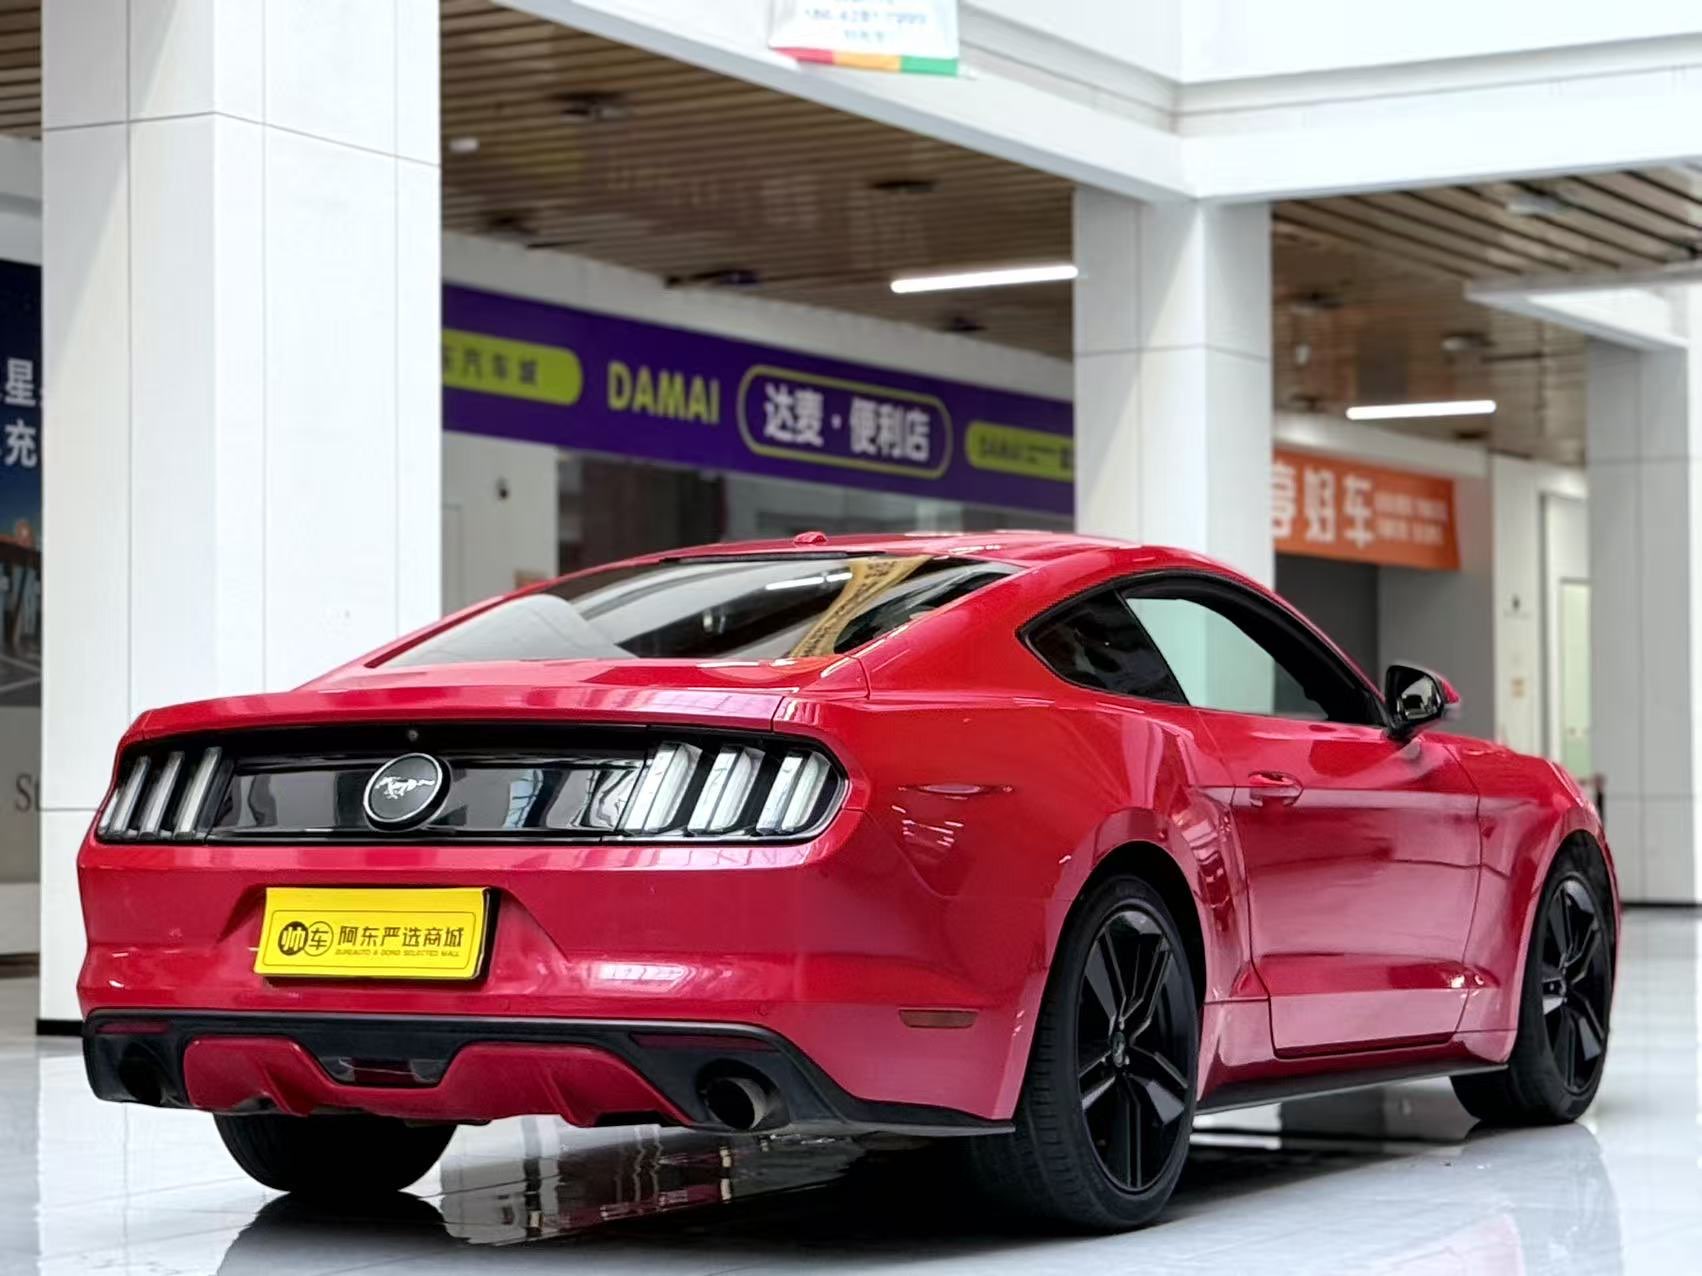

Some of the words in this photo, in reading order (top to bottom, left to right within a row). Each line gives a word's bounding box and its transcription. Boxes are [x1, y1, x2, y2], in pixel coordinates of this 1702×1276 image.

[606, 361, 720, 424] DAMAI
[4, 416, 37, 468] 充
[337, 925, 465, 948] 阿东严选商城
